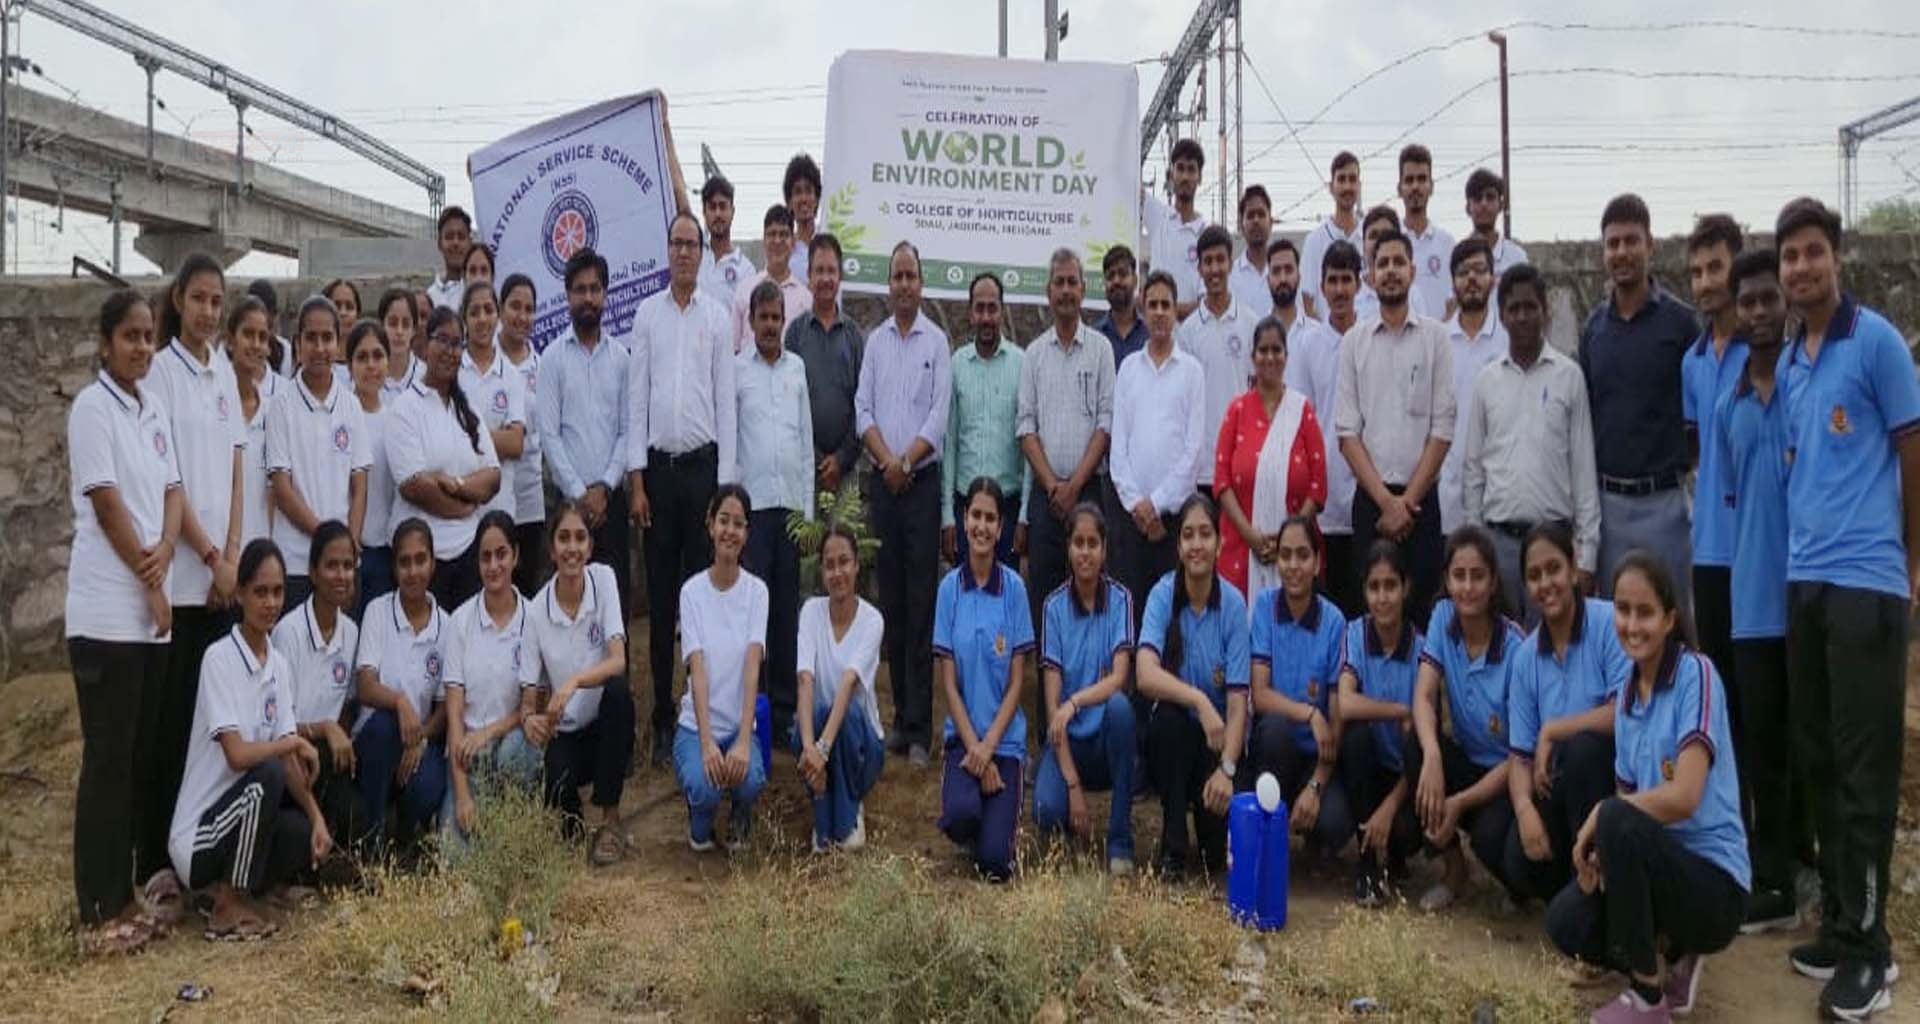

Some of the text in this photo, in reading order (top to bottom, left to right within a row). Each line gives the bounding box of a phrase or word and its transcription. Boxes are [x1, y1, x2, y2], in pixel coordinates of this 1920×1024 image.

[925, 111, 1041, 128] CELEBRATION OF
[901, 127, 1066, 169] WORLD
[871, 163, 1099, 197] ENVIRONMENT DAY
[488, 144, 654, 258] NATIONAL SERVICE SCHEME
[895, 202, 1075, 225] COLLEGE OF HORTICULTURE
[535, 309, 571, 333] OLLEGE
